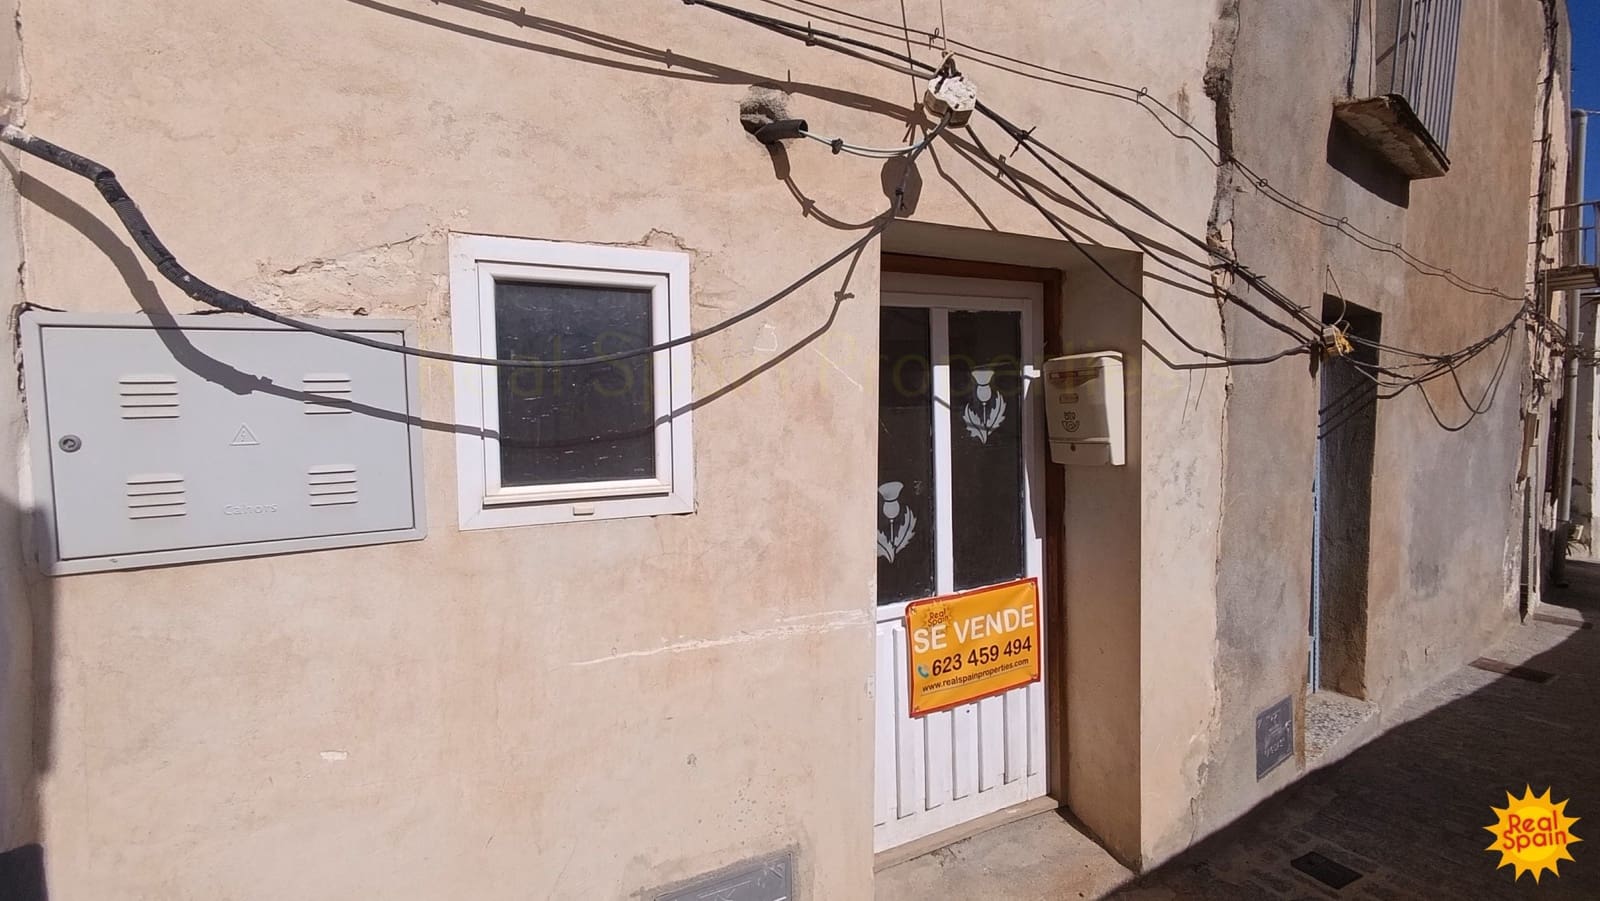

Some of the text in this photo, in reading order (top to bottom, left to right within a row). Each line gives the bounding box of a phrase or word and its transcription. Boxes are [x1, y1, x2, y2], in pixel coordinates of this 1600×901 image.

[913, 604, 1035, 654] SE VENDE
[927, 615, 949, 627] Spain
[929, 608, 947, 620] Real
[932, 636, 1032, 677] 623 459 494
[922, 658, 1029, 692] www.realspainproperties.com
